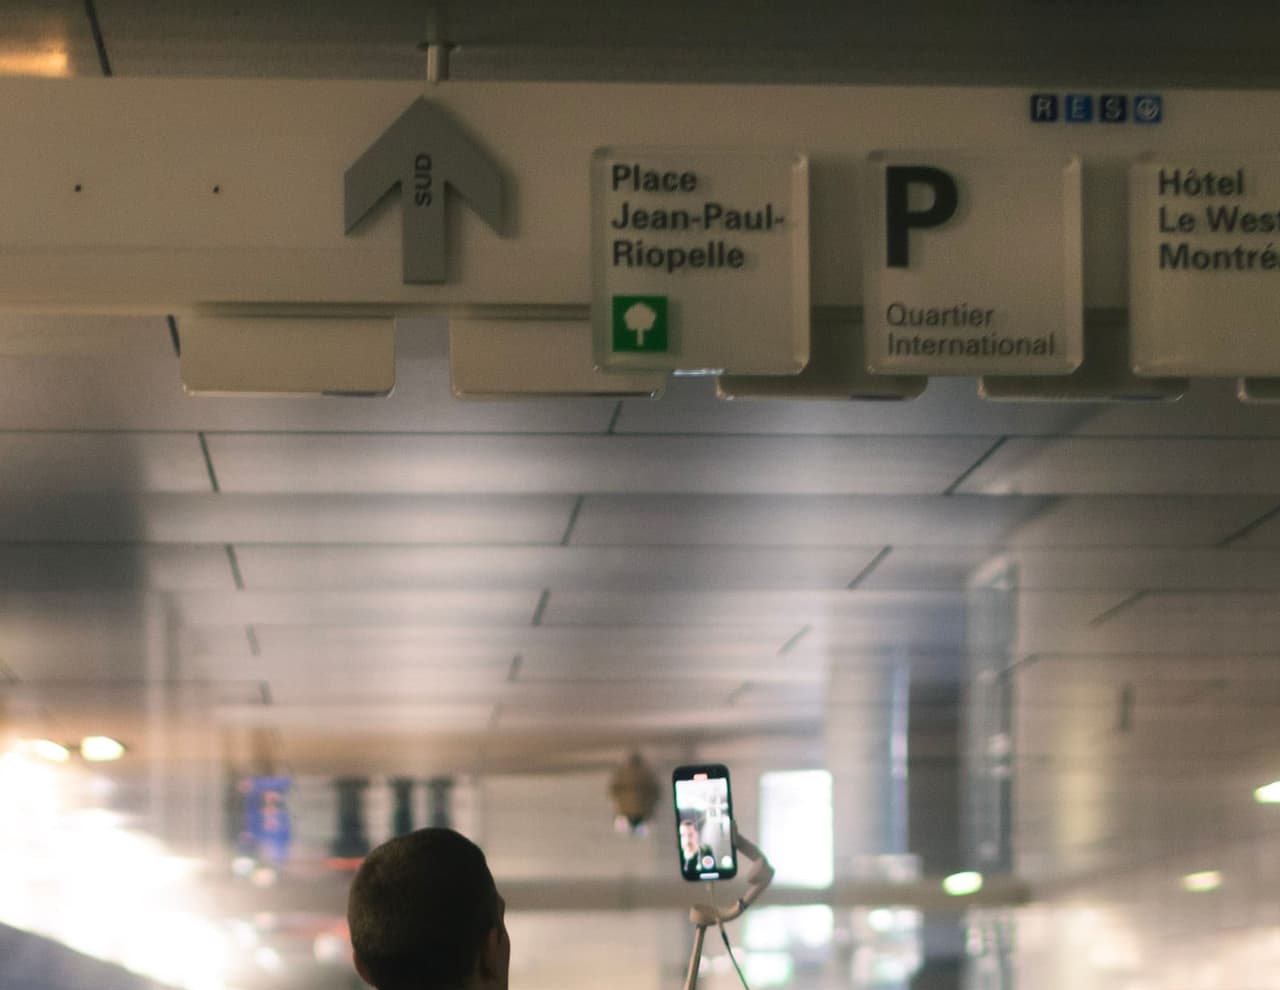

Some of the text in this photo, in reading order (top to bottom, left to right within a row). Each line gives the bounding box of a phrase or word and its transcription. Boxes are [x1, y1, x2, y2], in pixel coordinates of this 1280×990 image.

[415, 154, 432, 208] SUD
[612, 164, 698, 193] Place
[1159, 167, 1245, 196] Hôtel
[611, 202, 785, 231] Jean-Paul-
[886, 166, 959, 268] P
[1159, 207, 1197, 233] Le
[613, 240, 745, 274] Riopelle
[886, 302, 995, 327] Quartier
[888, 331, 1056, 357] International
